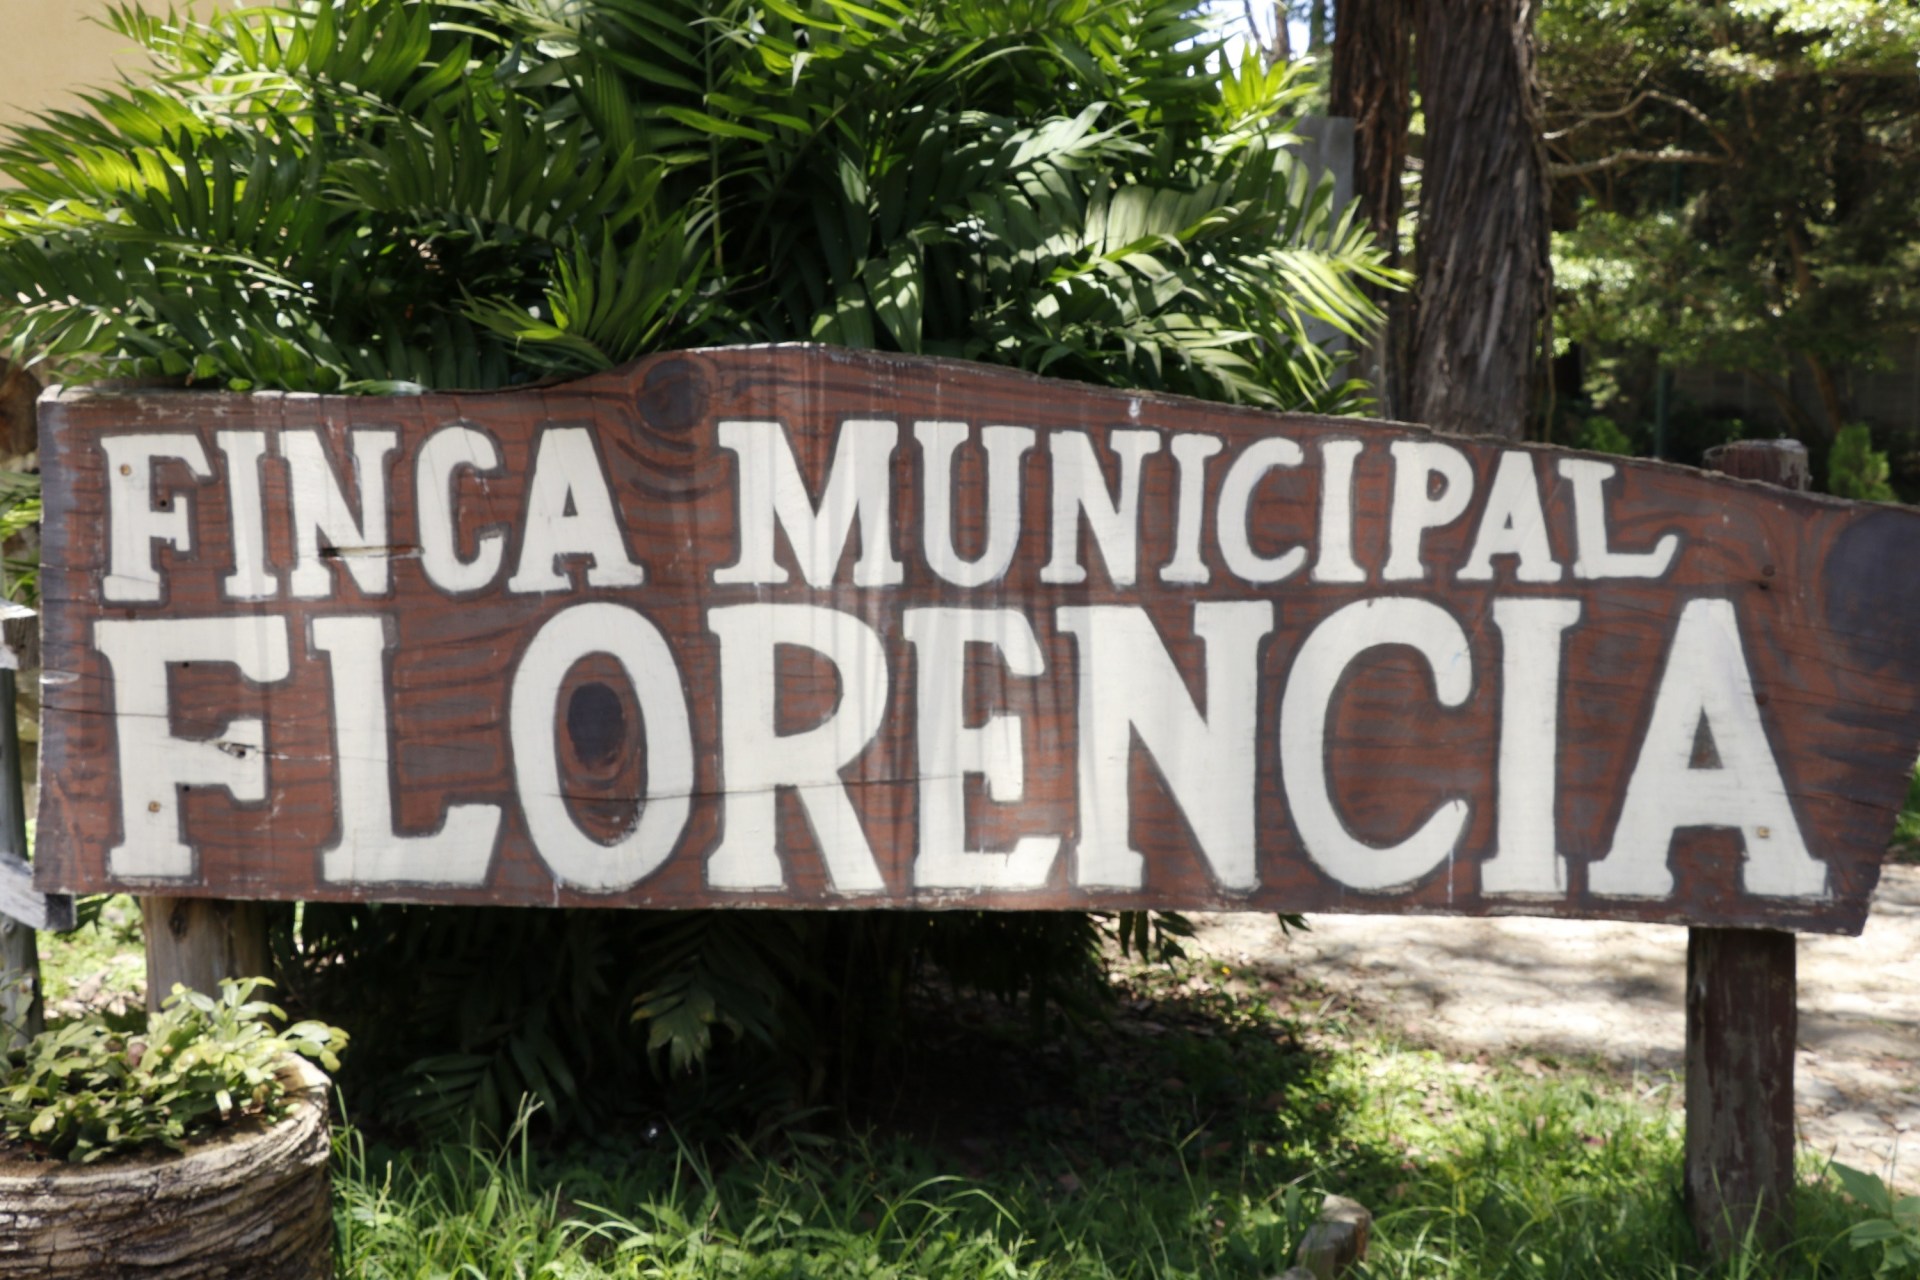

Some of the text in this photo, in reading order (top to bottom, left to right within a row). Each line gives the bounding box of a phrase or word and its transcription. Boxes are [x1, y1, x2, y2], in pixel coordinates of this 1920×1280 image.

[100, 418, 1679, 603] FINCA MUNICIPAL
[93, 597, 1829, 899] FLORENCIA
